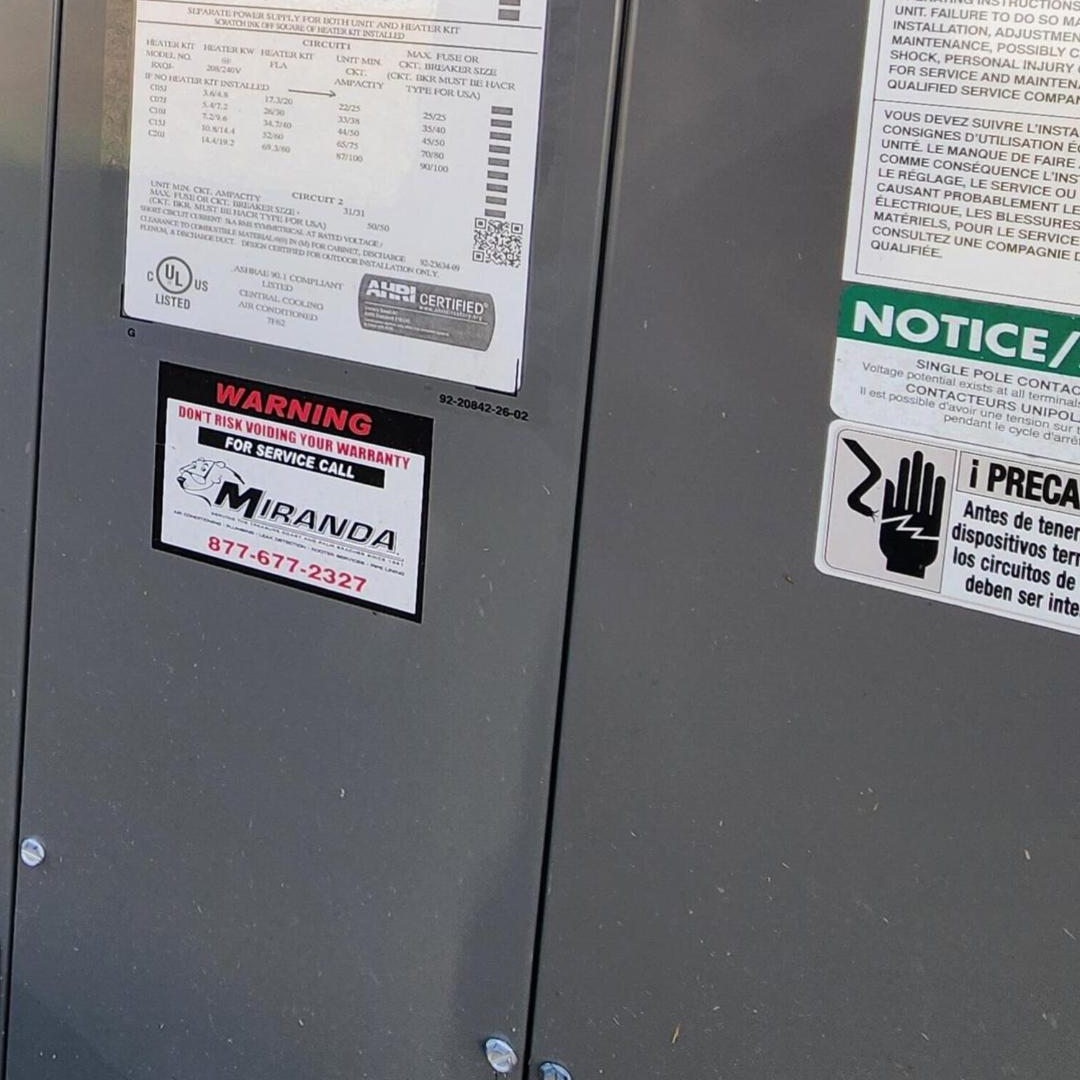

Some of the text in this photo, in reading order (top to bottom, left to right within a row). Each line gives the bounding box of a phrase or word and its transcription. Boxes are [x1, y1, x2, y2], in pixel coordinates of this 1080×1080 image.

[889, 49, 1074, 73] SHOCK, PERSONAL INJURY
[884, 109, 1023, 132] VOUS DEVEZ SUIVRE
[879, 153, 1039, 180] COMME CONSÉQUENCE
[146, 270, 154, 282] C
[165, 263, 182, 286] UL
[191, 275, 208, 292] US
[155, 293, 190, 309] LISTED
[126, 328, 136, 338] G
[916, 359, 969, 377] SINGLE
[973, 368, 1013, 384] POLE
[216, 382, 371, 435] WARNING
[438, 394, 528, 422] 92-20842-26-02
[178, 405, 410, 470] DON'T RISK VOIDING YOUR WARRANTY
[224, 436, 354, 479] FOR SERVICE CALL
[214, 480, 398, 552] MIRANDA
[963, 500, 1079, 541] Antes de tener
[951, 522, 1047, 559] dispositivos
[208, 536, 366, 592] 877-677-2327
[952, 546, 1075, 591] los circuitos de
[965, 574, 1012, 601] deben
[1017, 589, 1043, 608] ser
